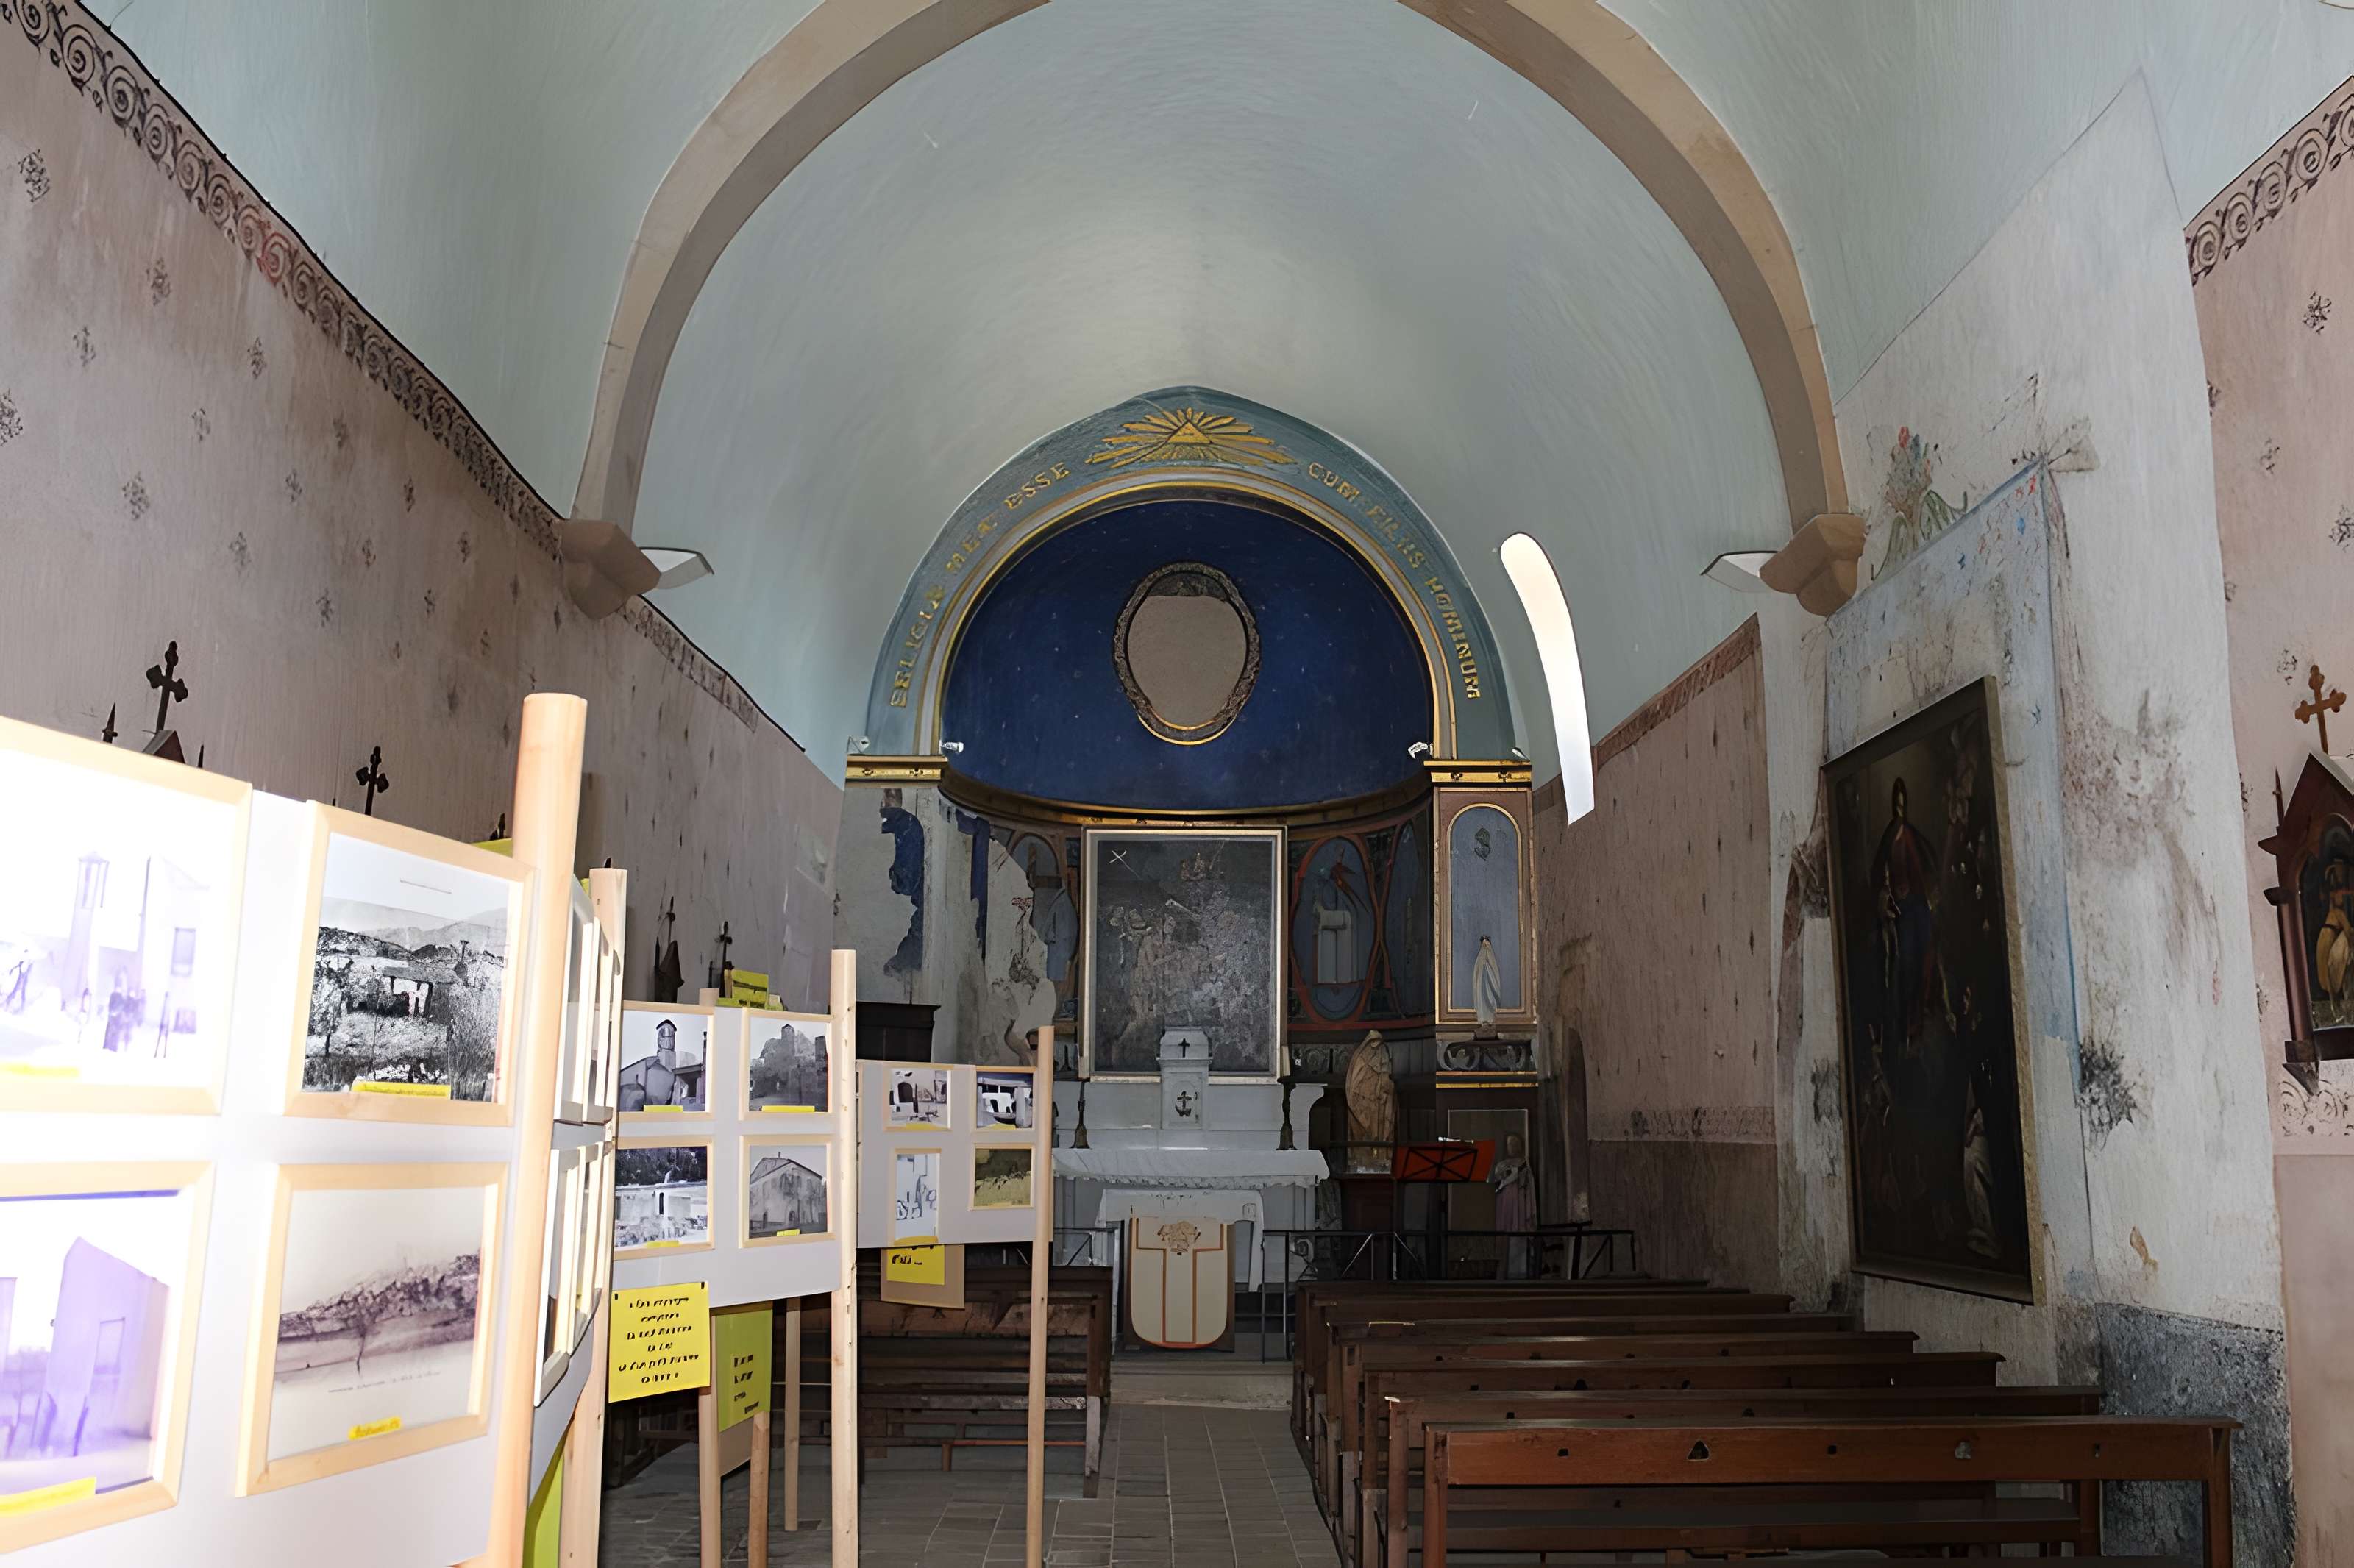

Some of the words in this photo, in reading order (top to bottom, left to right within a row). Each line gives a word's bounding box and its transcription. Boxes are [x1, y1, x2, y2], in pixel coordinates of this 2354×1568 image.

[1004, 462, 1071, 510] ESSE
[1308, 462, 1362, 503] CUM
[1425, 577, 1482, 699] HOMINUM
